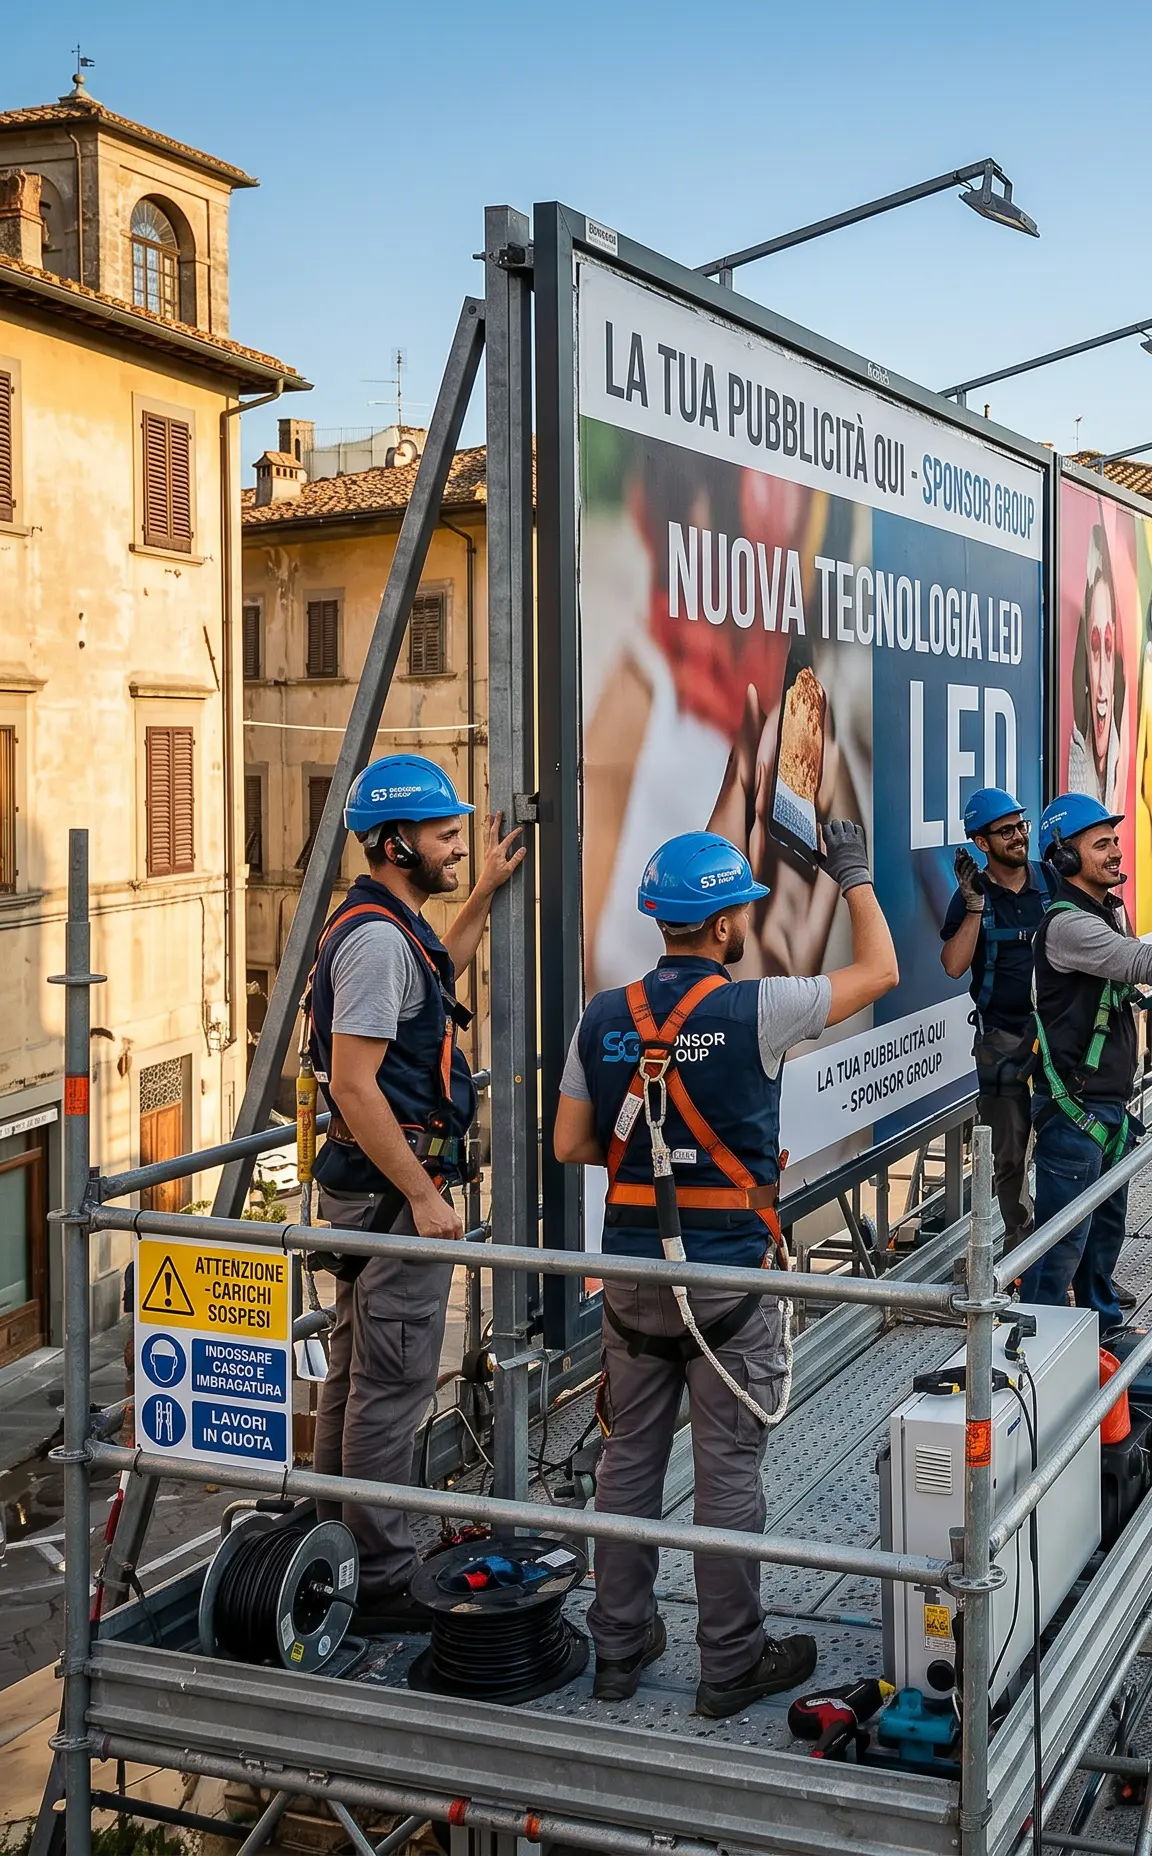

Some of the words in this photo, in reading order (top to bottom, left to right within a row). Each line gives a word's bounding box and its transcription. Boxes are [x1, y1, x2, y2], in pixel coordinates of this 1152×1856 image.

[605, 320, 649, 409] LA
[657, 343, 720, 432] TUA
[728, 371, 869, 484] PUBBLICITÀ
[873, 434, 906, 497] QUI
[922, 453, 992, 528] SPONSOR
[994, 484, 1035, 541] GROUP
[668, 521, 806, 636] NUOVA
[814, 555, 983, 660] TECNOLOGIA
[987, 596, 1023, 666] LED
[909, 679, 1018, 851] LED
[674, 1032, 726, 1047] NSOR
[675, 1048, 710, 1063] OUP
[817, 1067, 834, 1093] LA
[836, 1056, 861, 1083] TUA
[863, 1024, 926, 1072] PUBBLICITÀ
[927, 1019, 946, 1045] QUI
[850, 1070, 904, 1113] SPONSOR
[906, 1052, 943, 1086] GROUP
[195, 1256, 284, 1284] ATTENZIONE
[208, 1303, 271, 1329] SOSPESI
[205, 1344, 272, 1366] INDOSSARE
[212, 1361, 254, 1377] CASCO
[257, 1366, 265, 1380] E
[196, 1374, 282, 1397] IMBRAGATURA
[211, 1410, 267, 1432] LAVORI
[203, 1427, 218, 1443] IN
[221, 1431, 273, 1451] QUOTA
